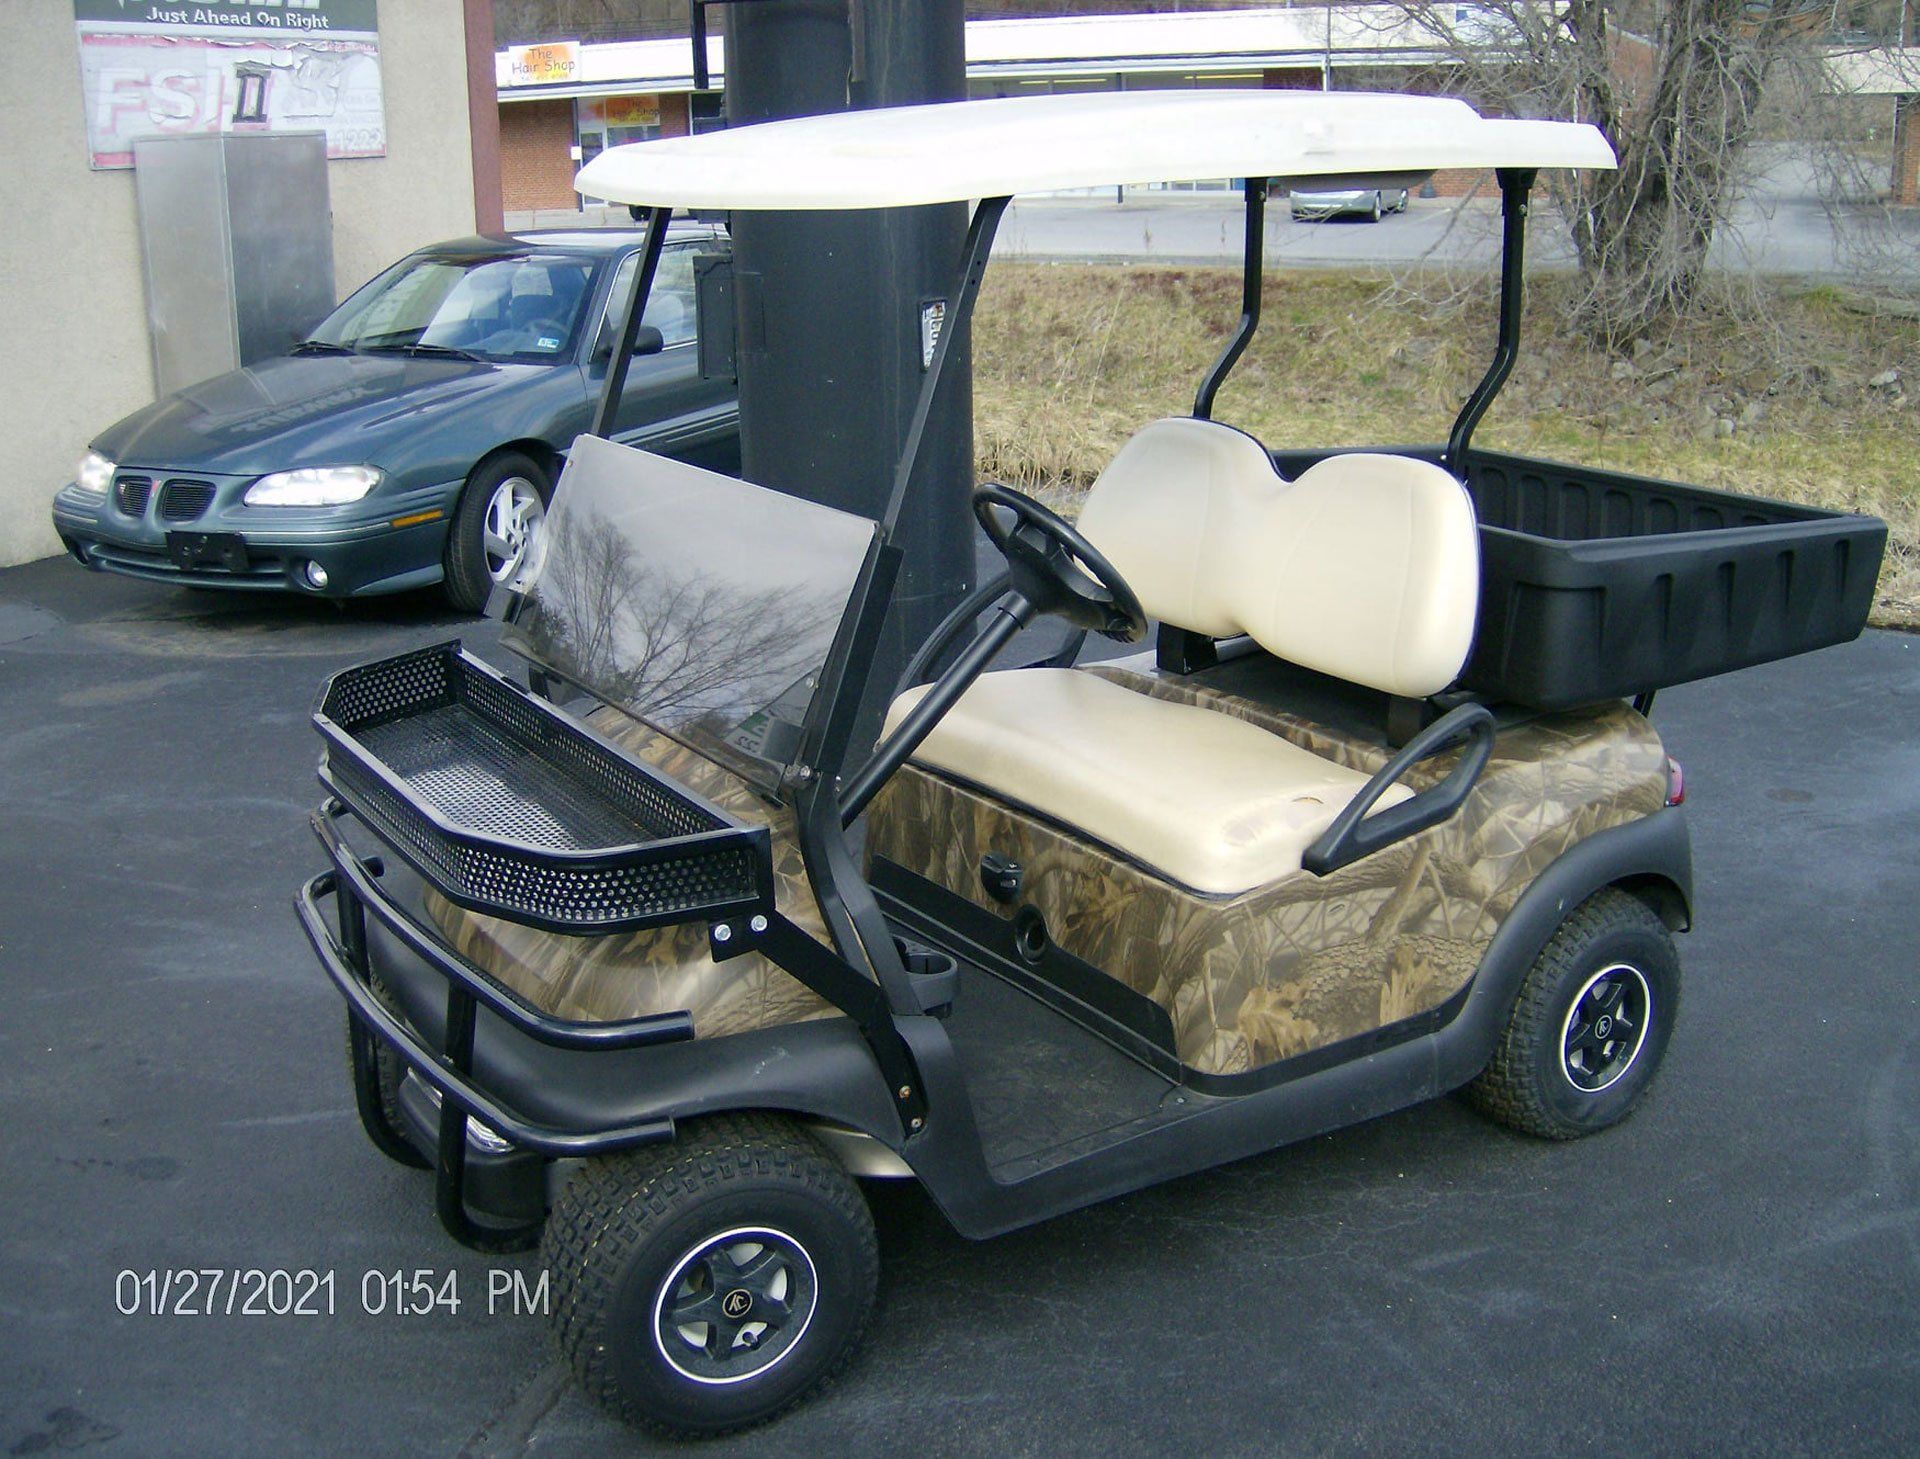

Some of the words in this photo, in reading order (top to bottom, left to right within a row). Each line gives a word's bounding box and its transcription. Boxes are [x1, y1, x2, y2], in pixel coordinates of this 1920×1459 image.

[146, 7, 188, 24] Just
[193, 9, 251, 26] Ahead
[257, 11, 281, 27] On
[286, 13, 330, 32] Right
[528, 47, 553, 60] The
[511, 61, 540, 75] Hair
[544, 60, 576, 73] Shop
